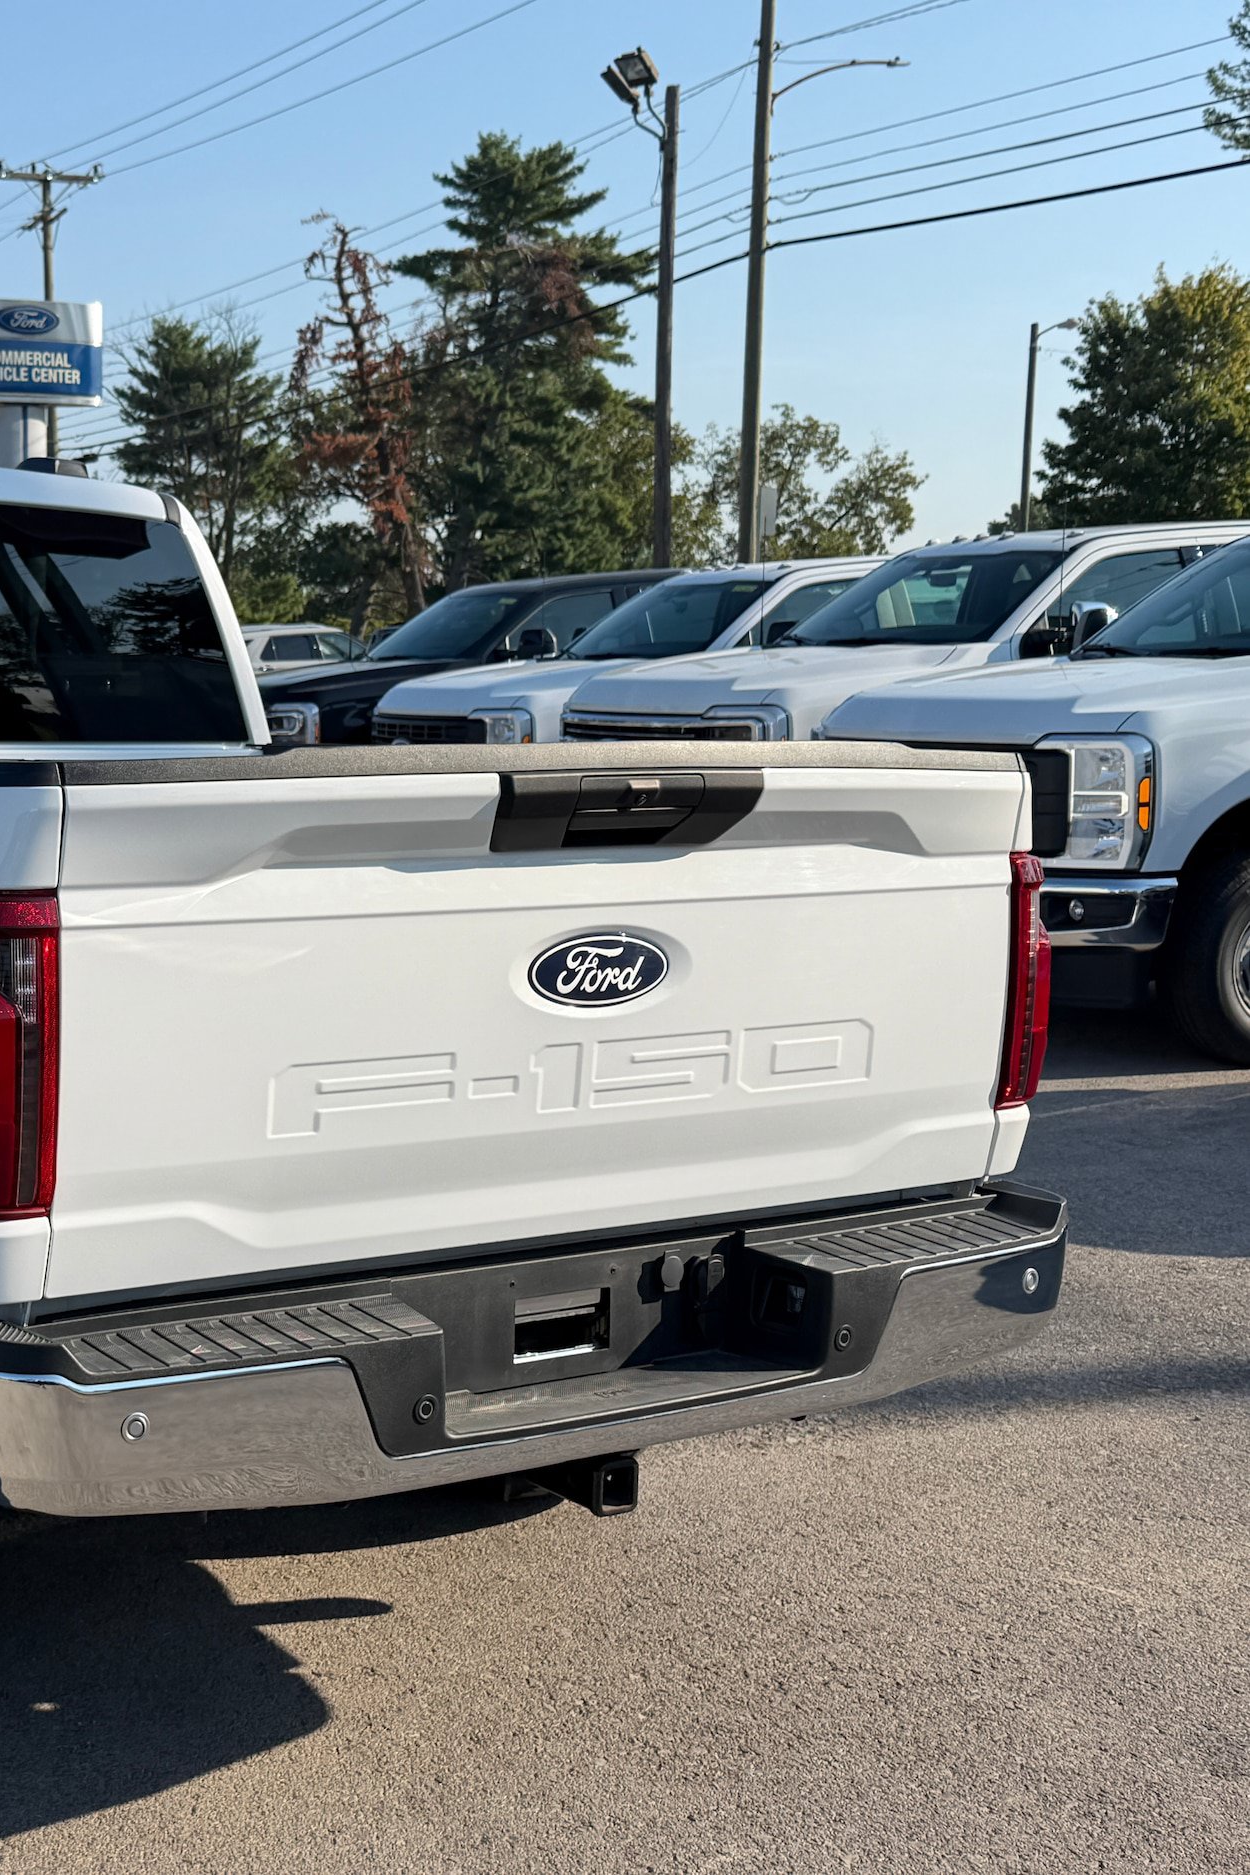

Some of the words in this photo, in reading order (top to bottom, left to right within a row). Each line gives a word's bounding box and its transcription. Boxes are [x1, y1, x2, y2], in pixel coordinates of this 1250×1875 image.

[10, 311, 48, 329] Ford
[31, 367, 81, 385] CENTER
[556, 946, 645, 994] Ford
[267, 1018, 874, 1139] F-150
